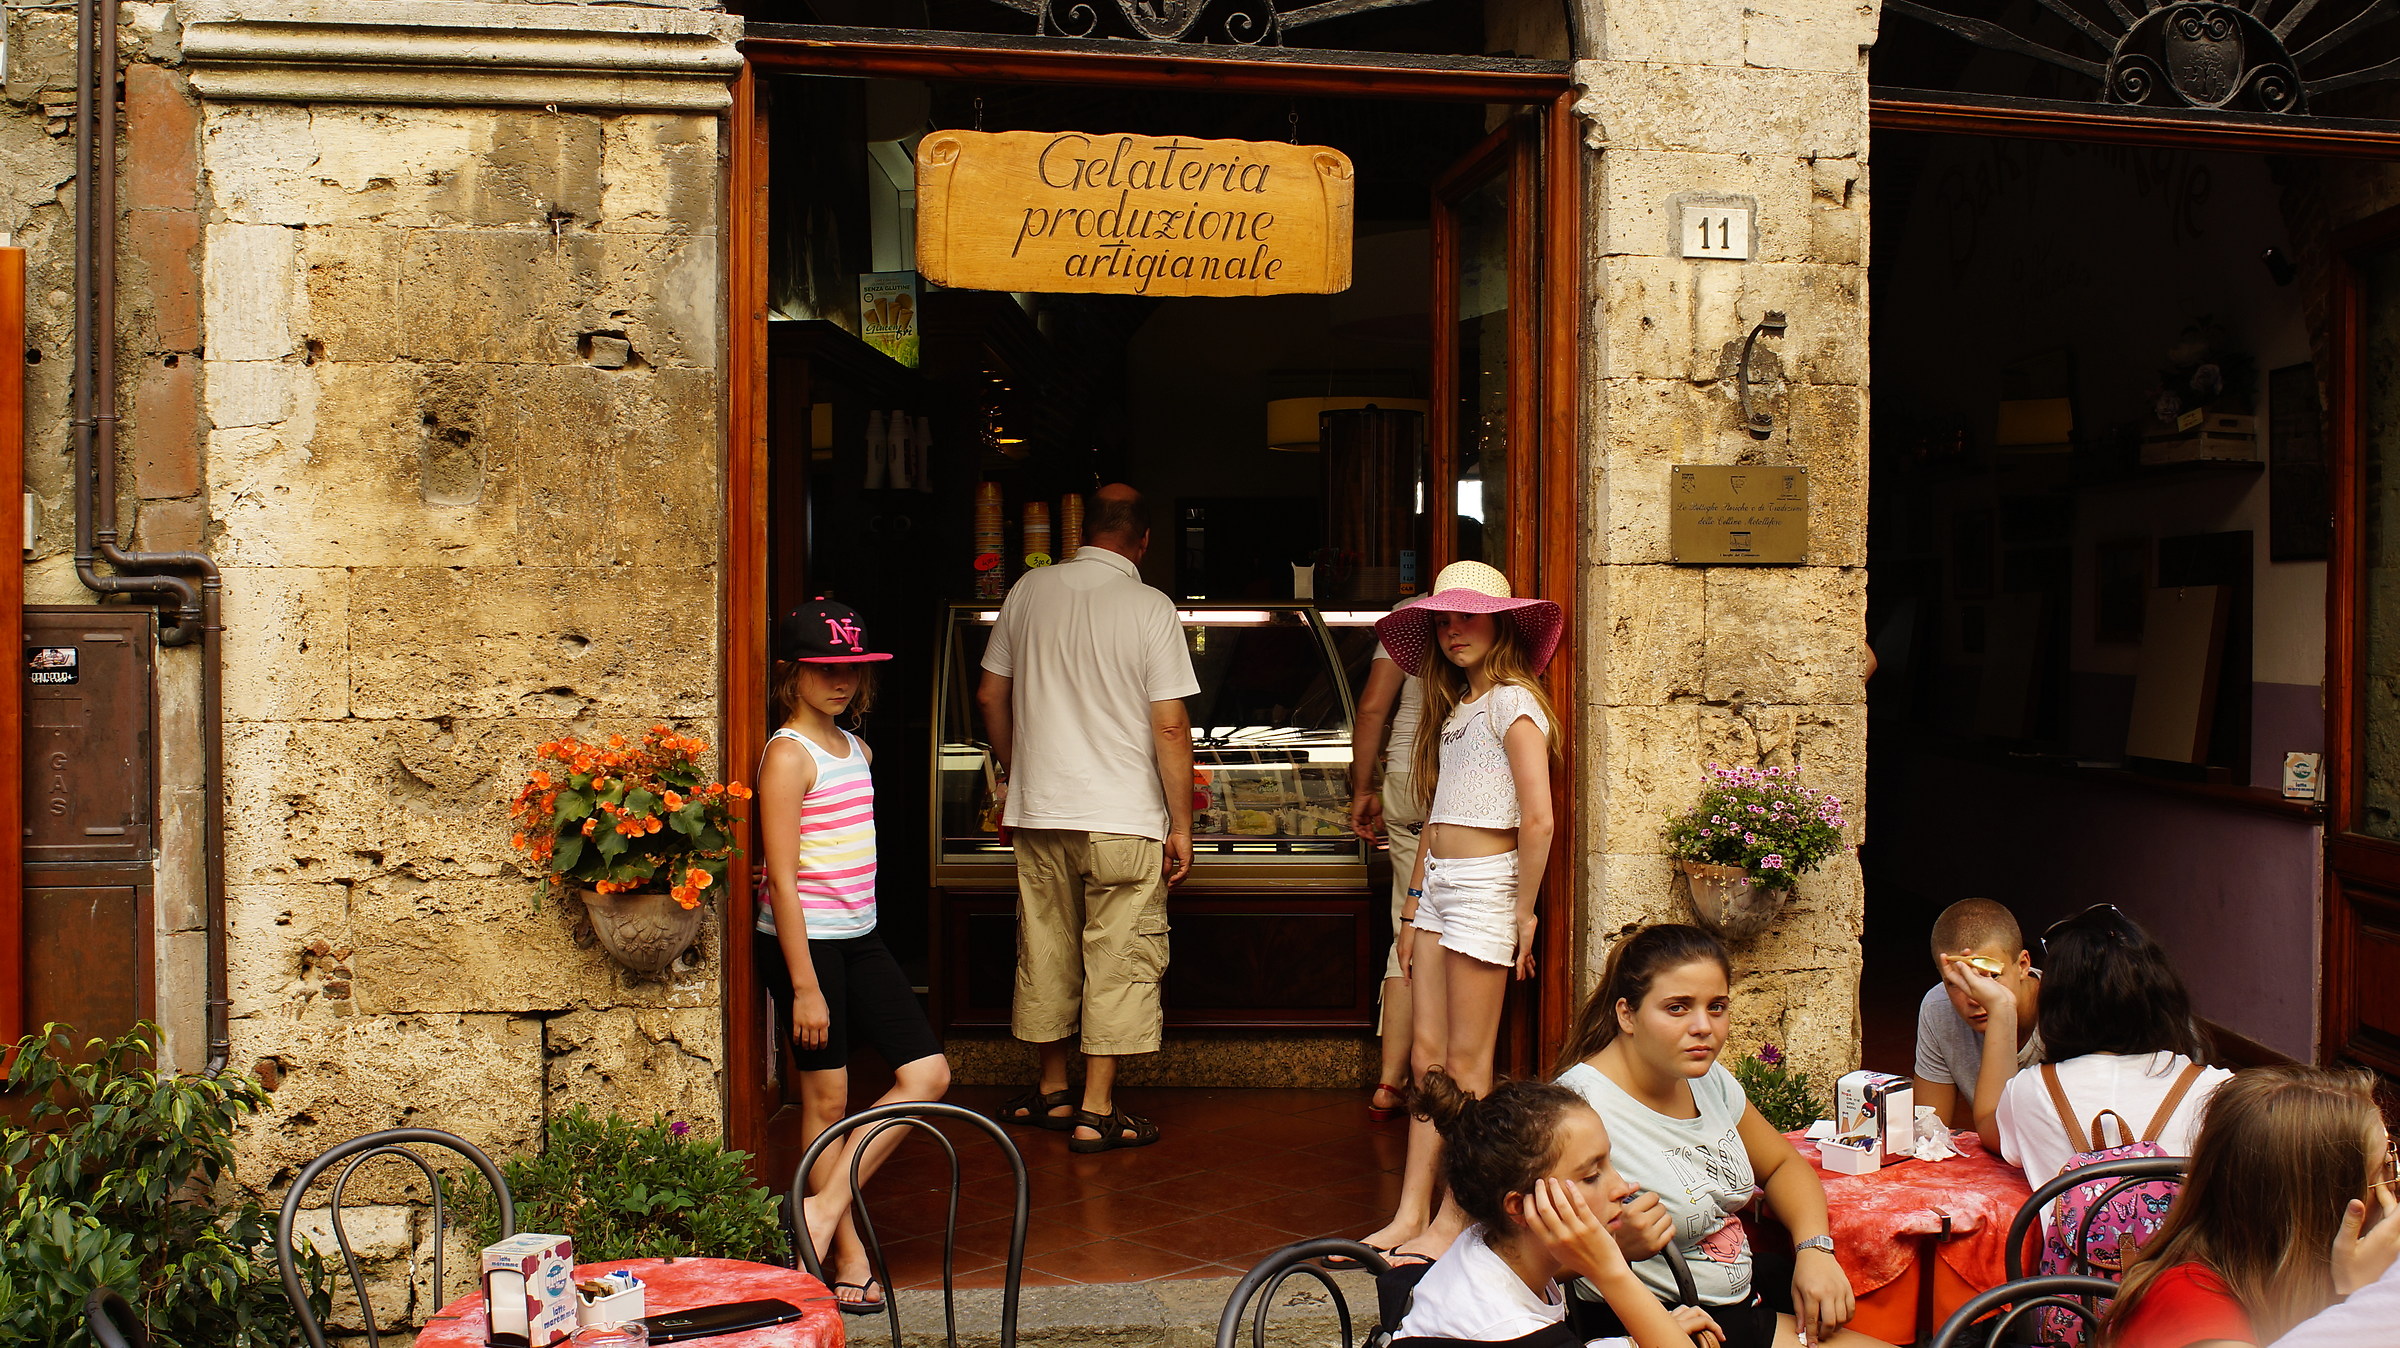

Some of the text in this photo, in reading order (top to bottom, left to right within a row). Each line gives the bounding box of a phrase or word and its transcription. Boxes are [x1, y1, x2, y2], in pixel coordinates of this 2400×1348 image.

[1038, 134, 1270, 194] Gelateria
[1011, 189, 1275, 258] produzione
[1698, 216, 1730, 250] 11
[1064, 239, 1283, 294] artigianale
[825, 618, 864, 653] NY
[48, 751, 69, 817] GAS
[543, 1309, 575, 1329] maremma
[552, 1304, 566, 1317] latte
